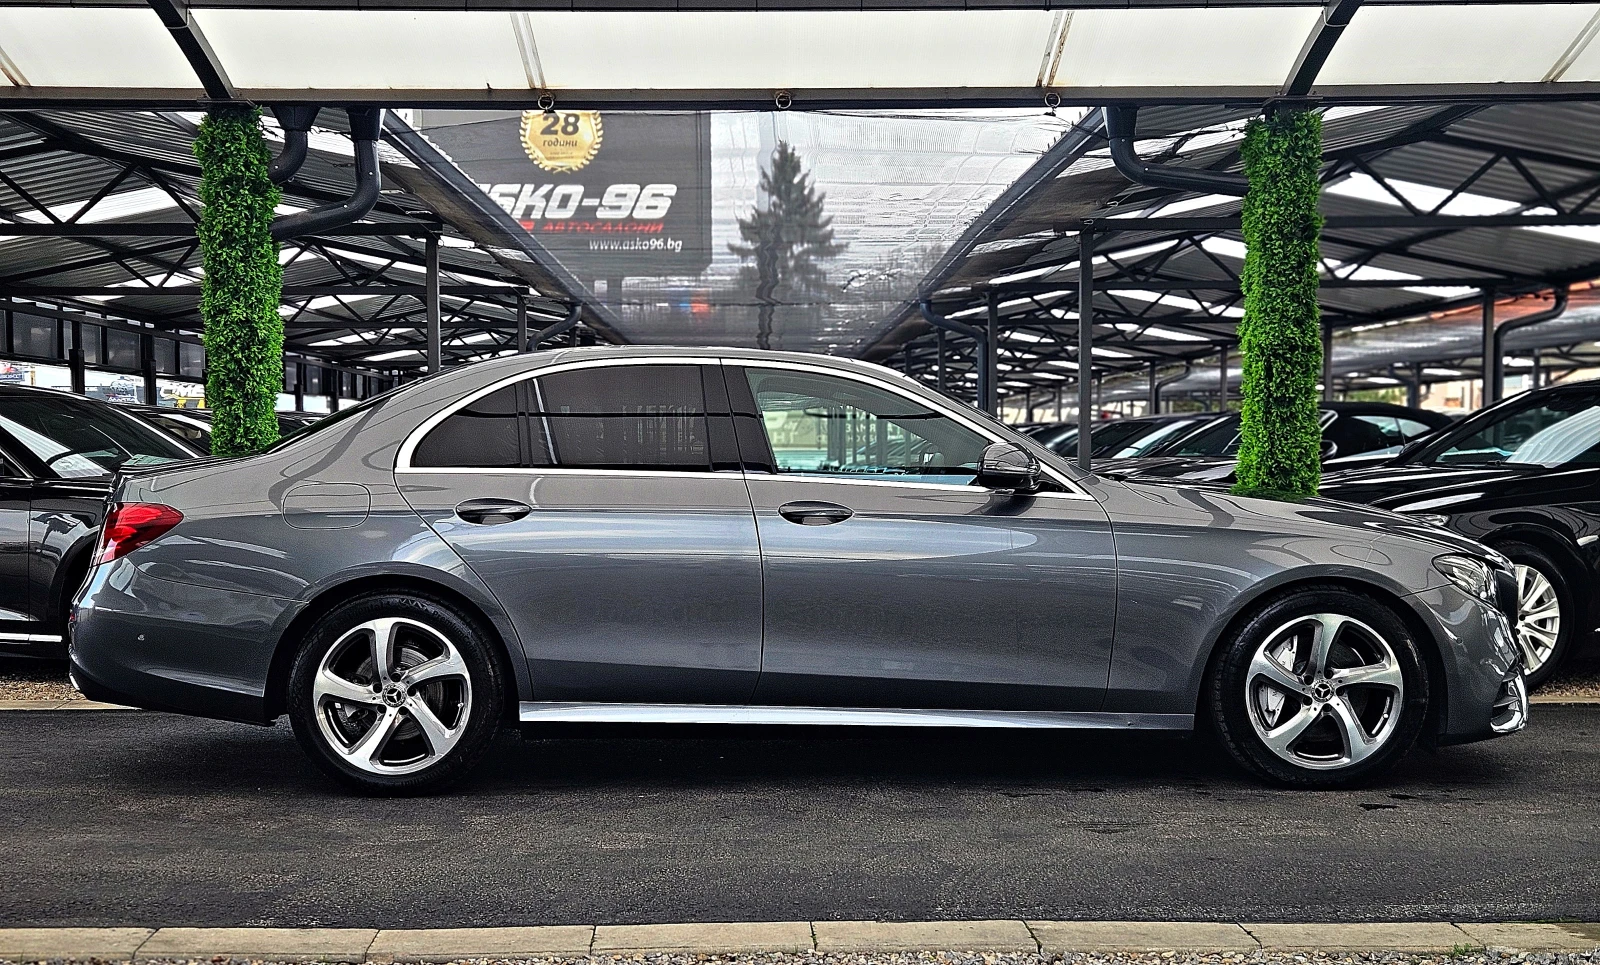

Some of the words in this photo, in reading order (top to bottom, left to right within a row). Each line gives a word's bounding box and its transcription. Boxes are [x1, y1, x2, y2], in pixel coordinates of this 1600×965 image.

[540, 113, 580, 136] 28
[542, 138, 578, 148] години
[480, 183, 678, 219] SKO-96
[588, 237, 683, 253] www.asko96.bg
